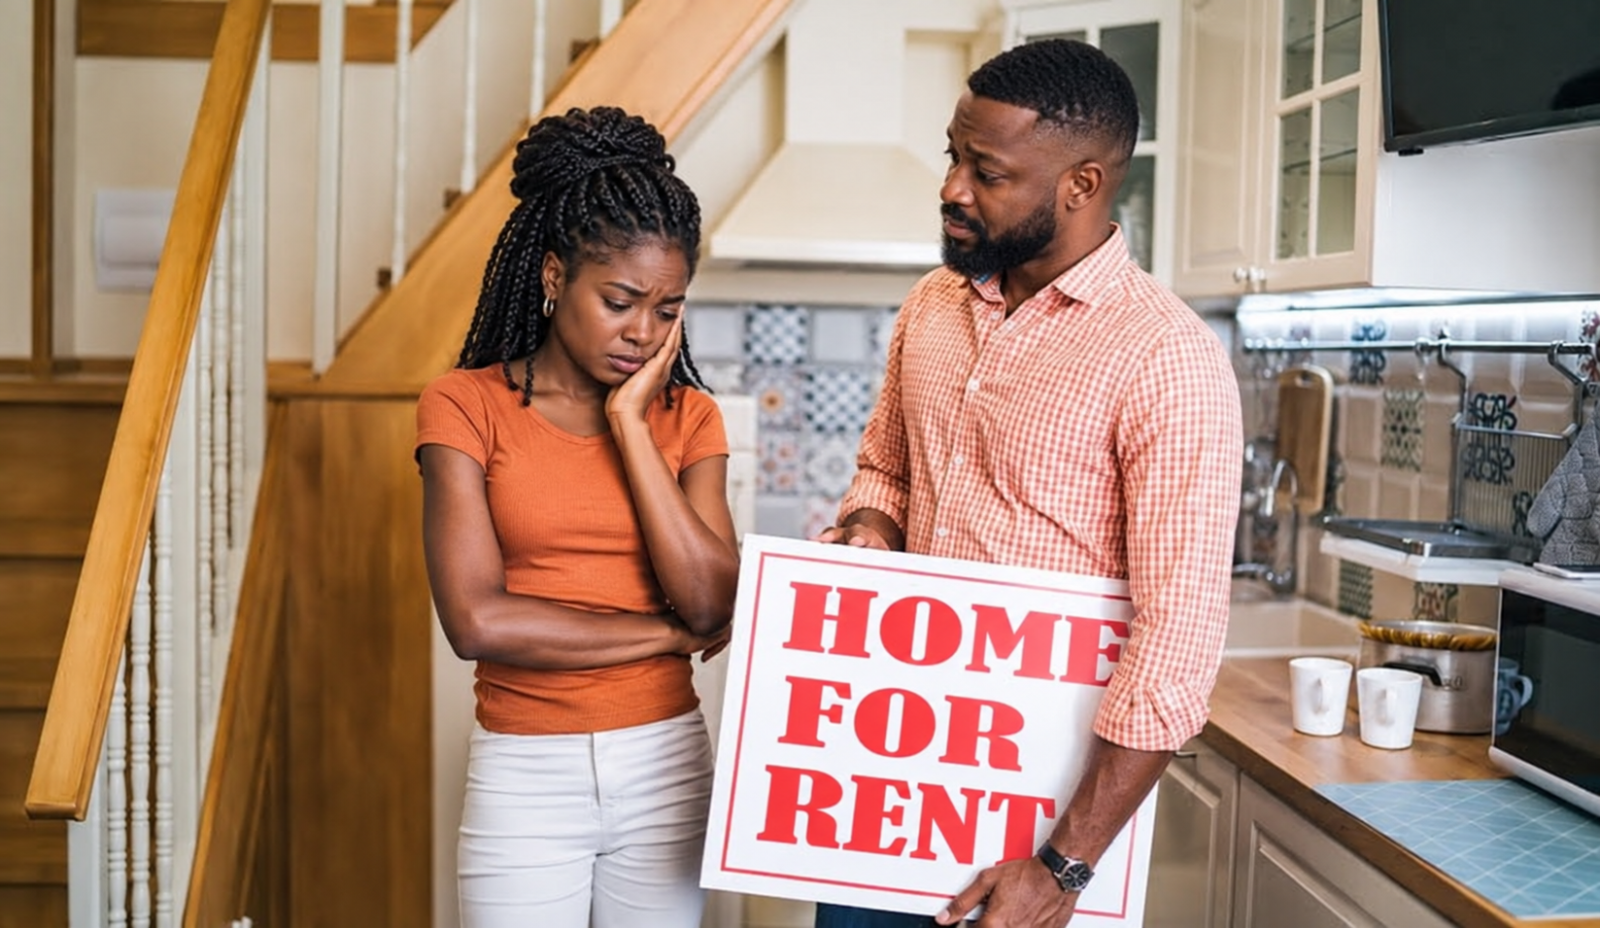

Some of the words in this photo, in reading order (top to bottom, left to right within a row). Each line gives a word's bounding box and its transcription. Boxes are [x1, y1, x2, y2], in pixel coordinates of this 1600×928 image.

[782, 581, 1130, 687] HOME
[778, 676, 1024, 771] FOR
[756, 765, 1056, 867] RENT
